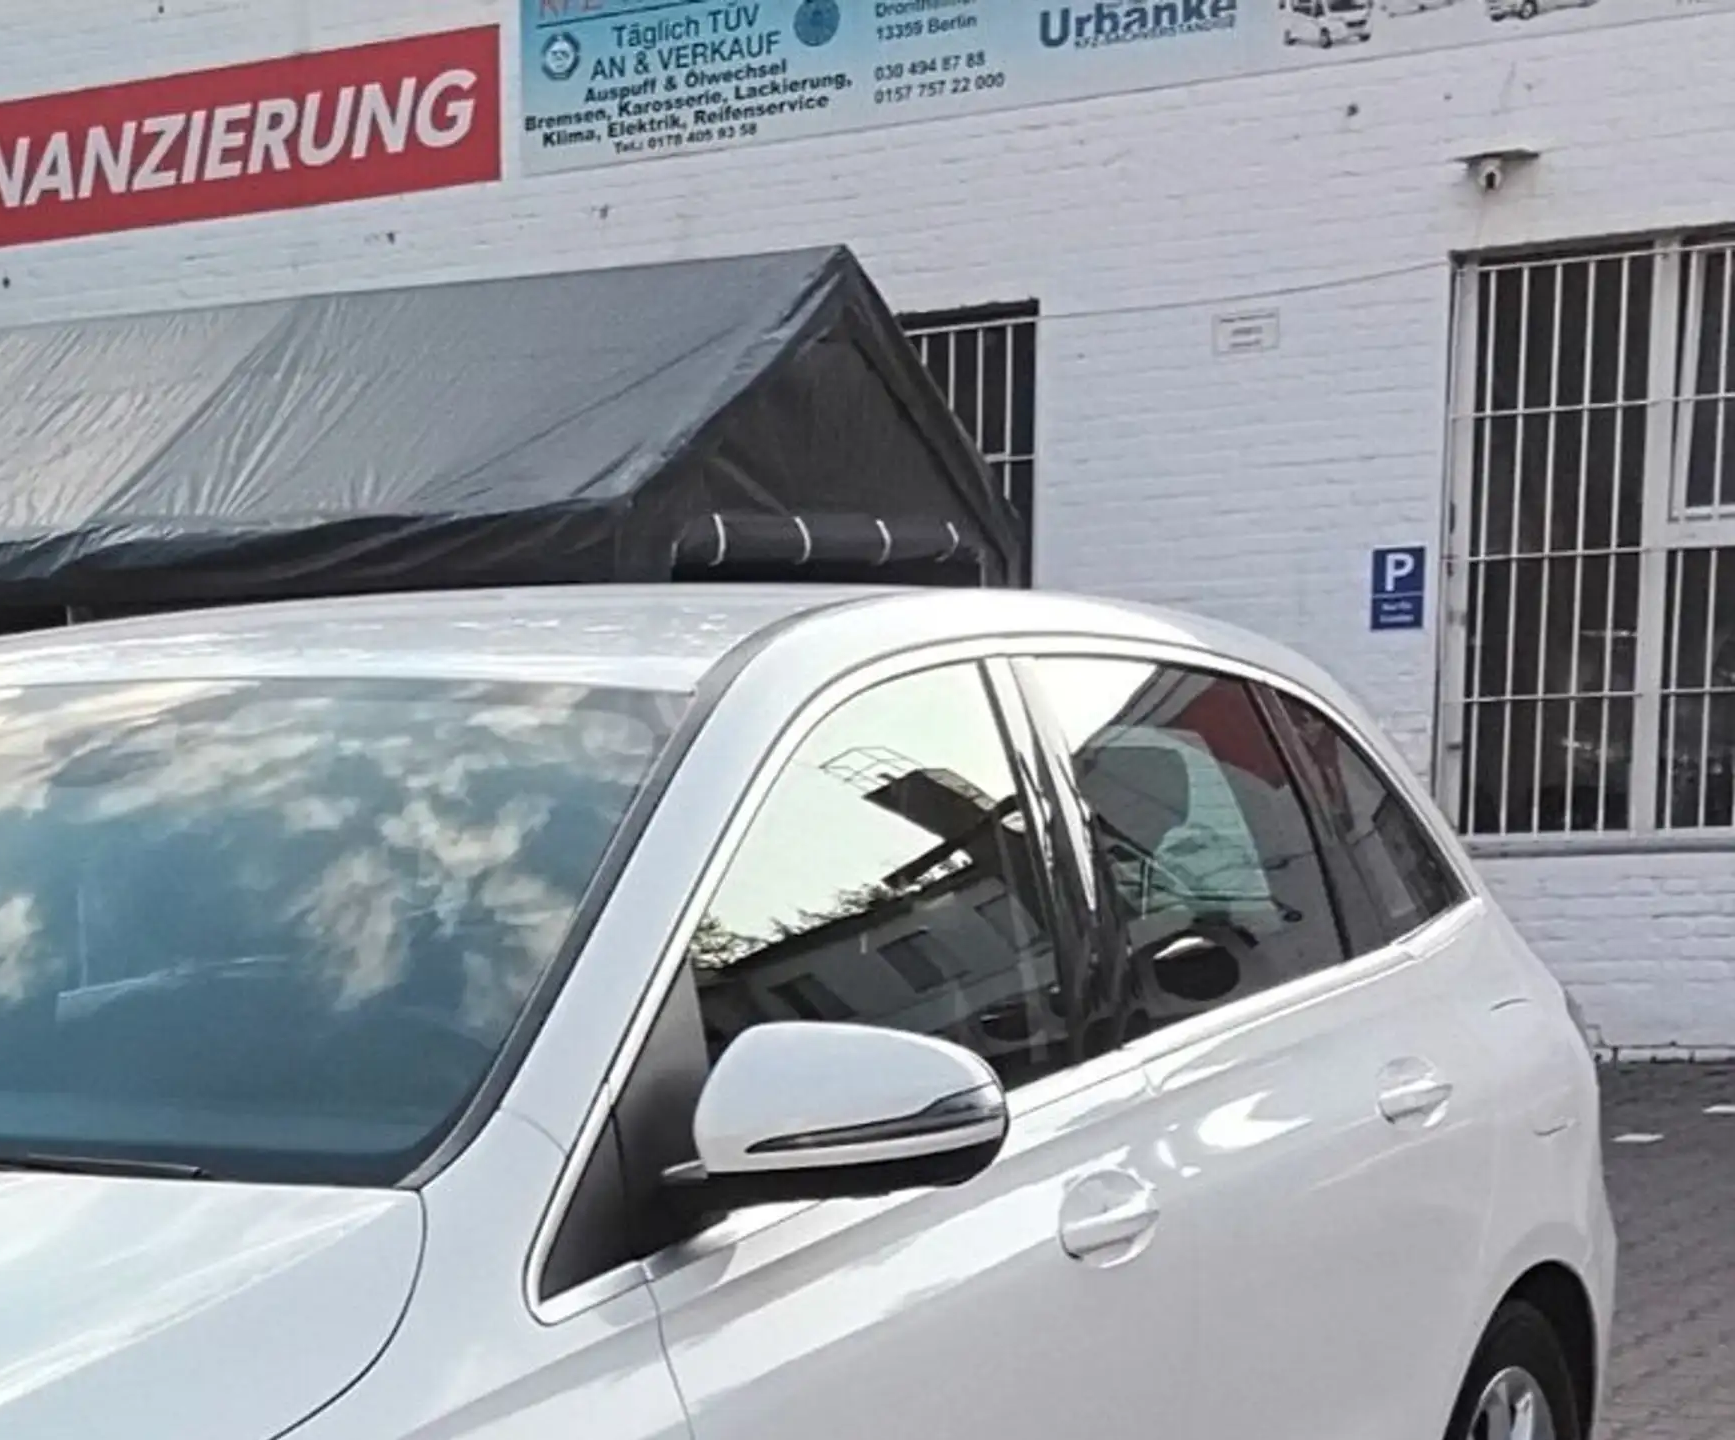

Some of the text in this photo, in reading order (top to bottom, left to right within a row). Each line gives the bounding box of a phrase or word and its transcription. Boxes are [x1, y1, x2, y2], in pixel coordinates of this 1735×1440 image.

[611, 3, 759, 49] Täglich TÜV
[928, 14, 977, 34] Berlin
[591, 30, 781, 80] AN & VERKAUF
[874, 63, 903, 81] 030
[525, 72, 852, 132] Bremsen, Karosserie, Lackierung,
[584, 78, 656, 104] Auspuff
[663, 75, 677, 92] &
[874, 71, 1005, 104] 0157 757 22 000
[543, 95, 829, 148] Klima, Elektrik, Reifenservice
[1385, 552, 1415, 592] P
